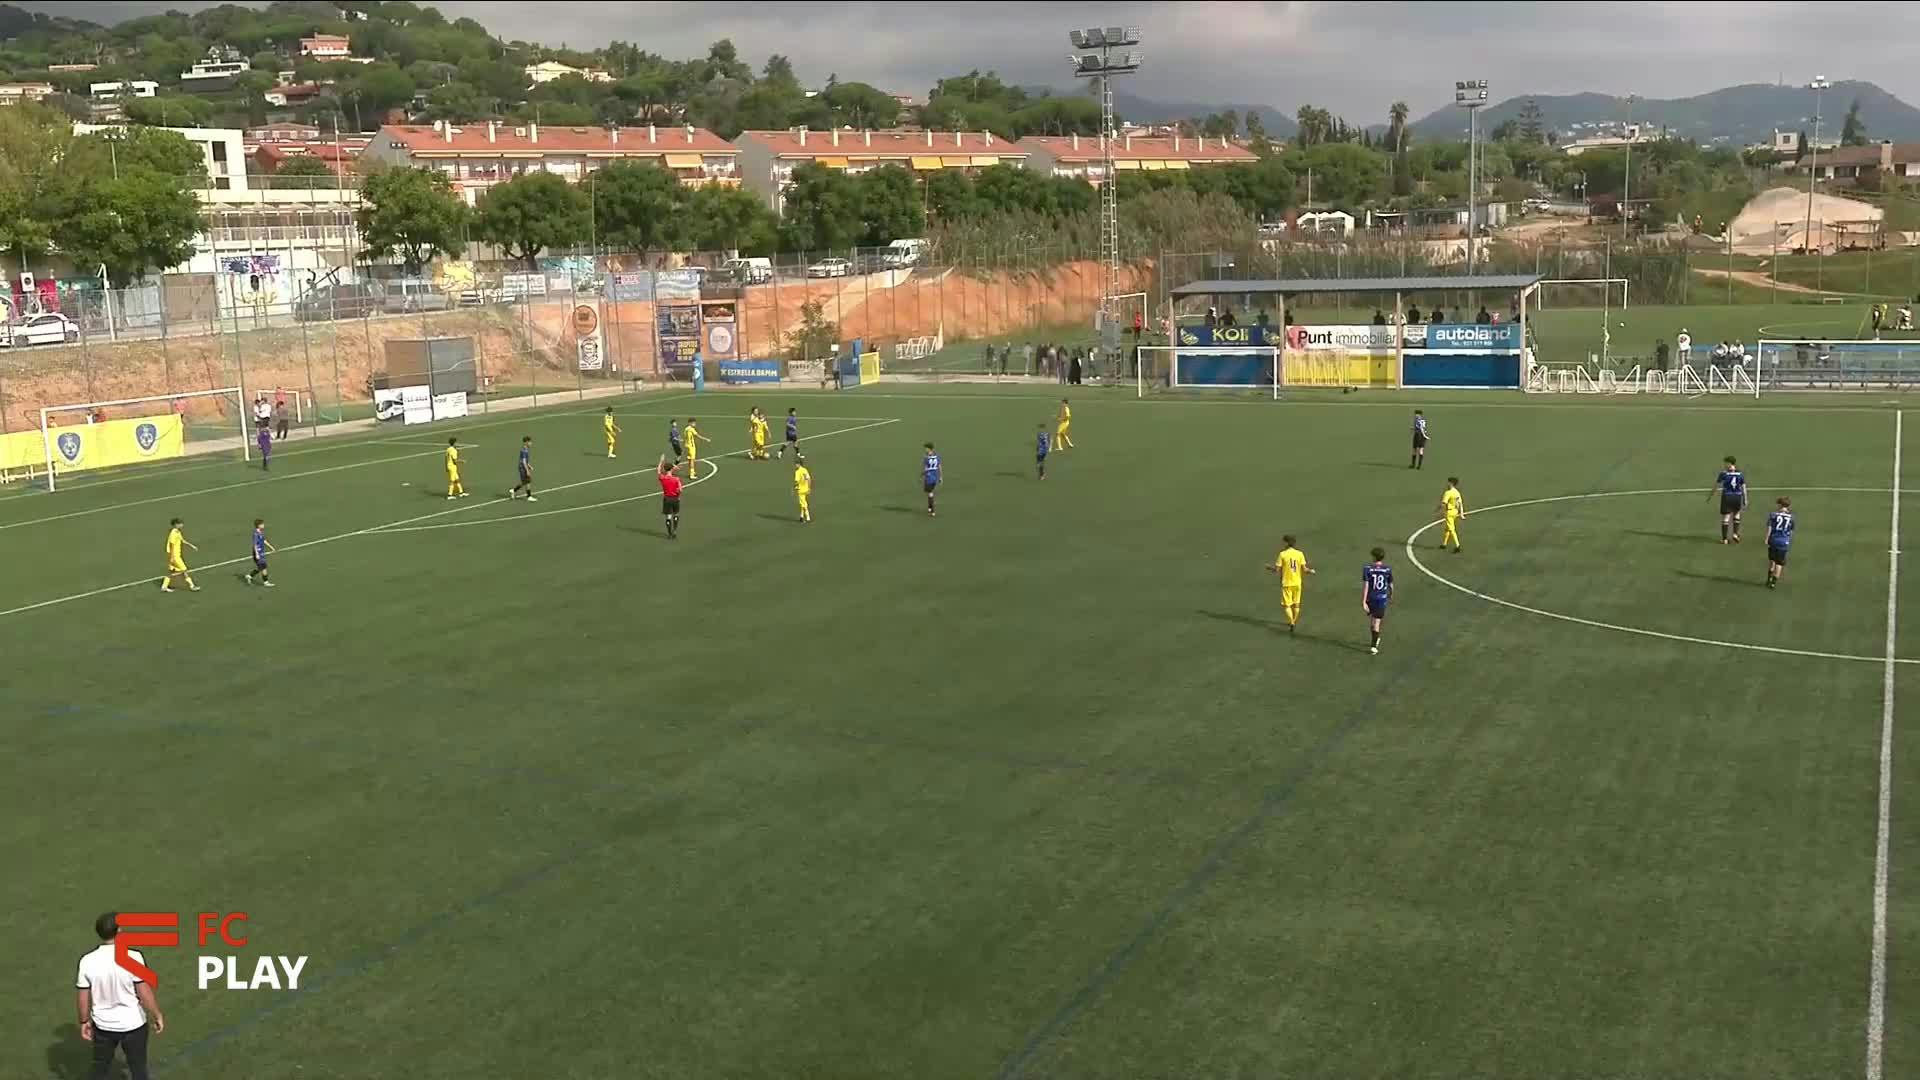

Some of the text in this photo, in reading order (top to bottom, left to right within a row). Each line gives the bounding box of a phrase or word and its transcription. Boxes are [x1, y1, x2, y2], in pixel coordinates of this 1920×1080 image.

[1298, 331, 1332, 344] Punt
[1436, 327, 1511, 340] autoland
[727, 368, 777, 377] ESTRELLA DAMM
[1730, 476, 1737, 489] 4
[1775, 515, 1792, 532] 27
[1371, 574, 1385, 590] 18
